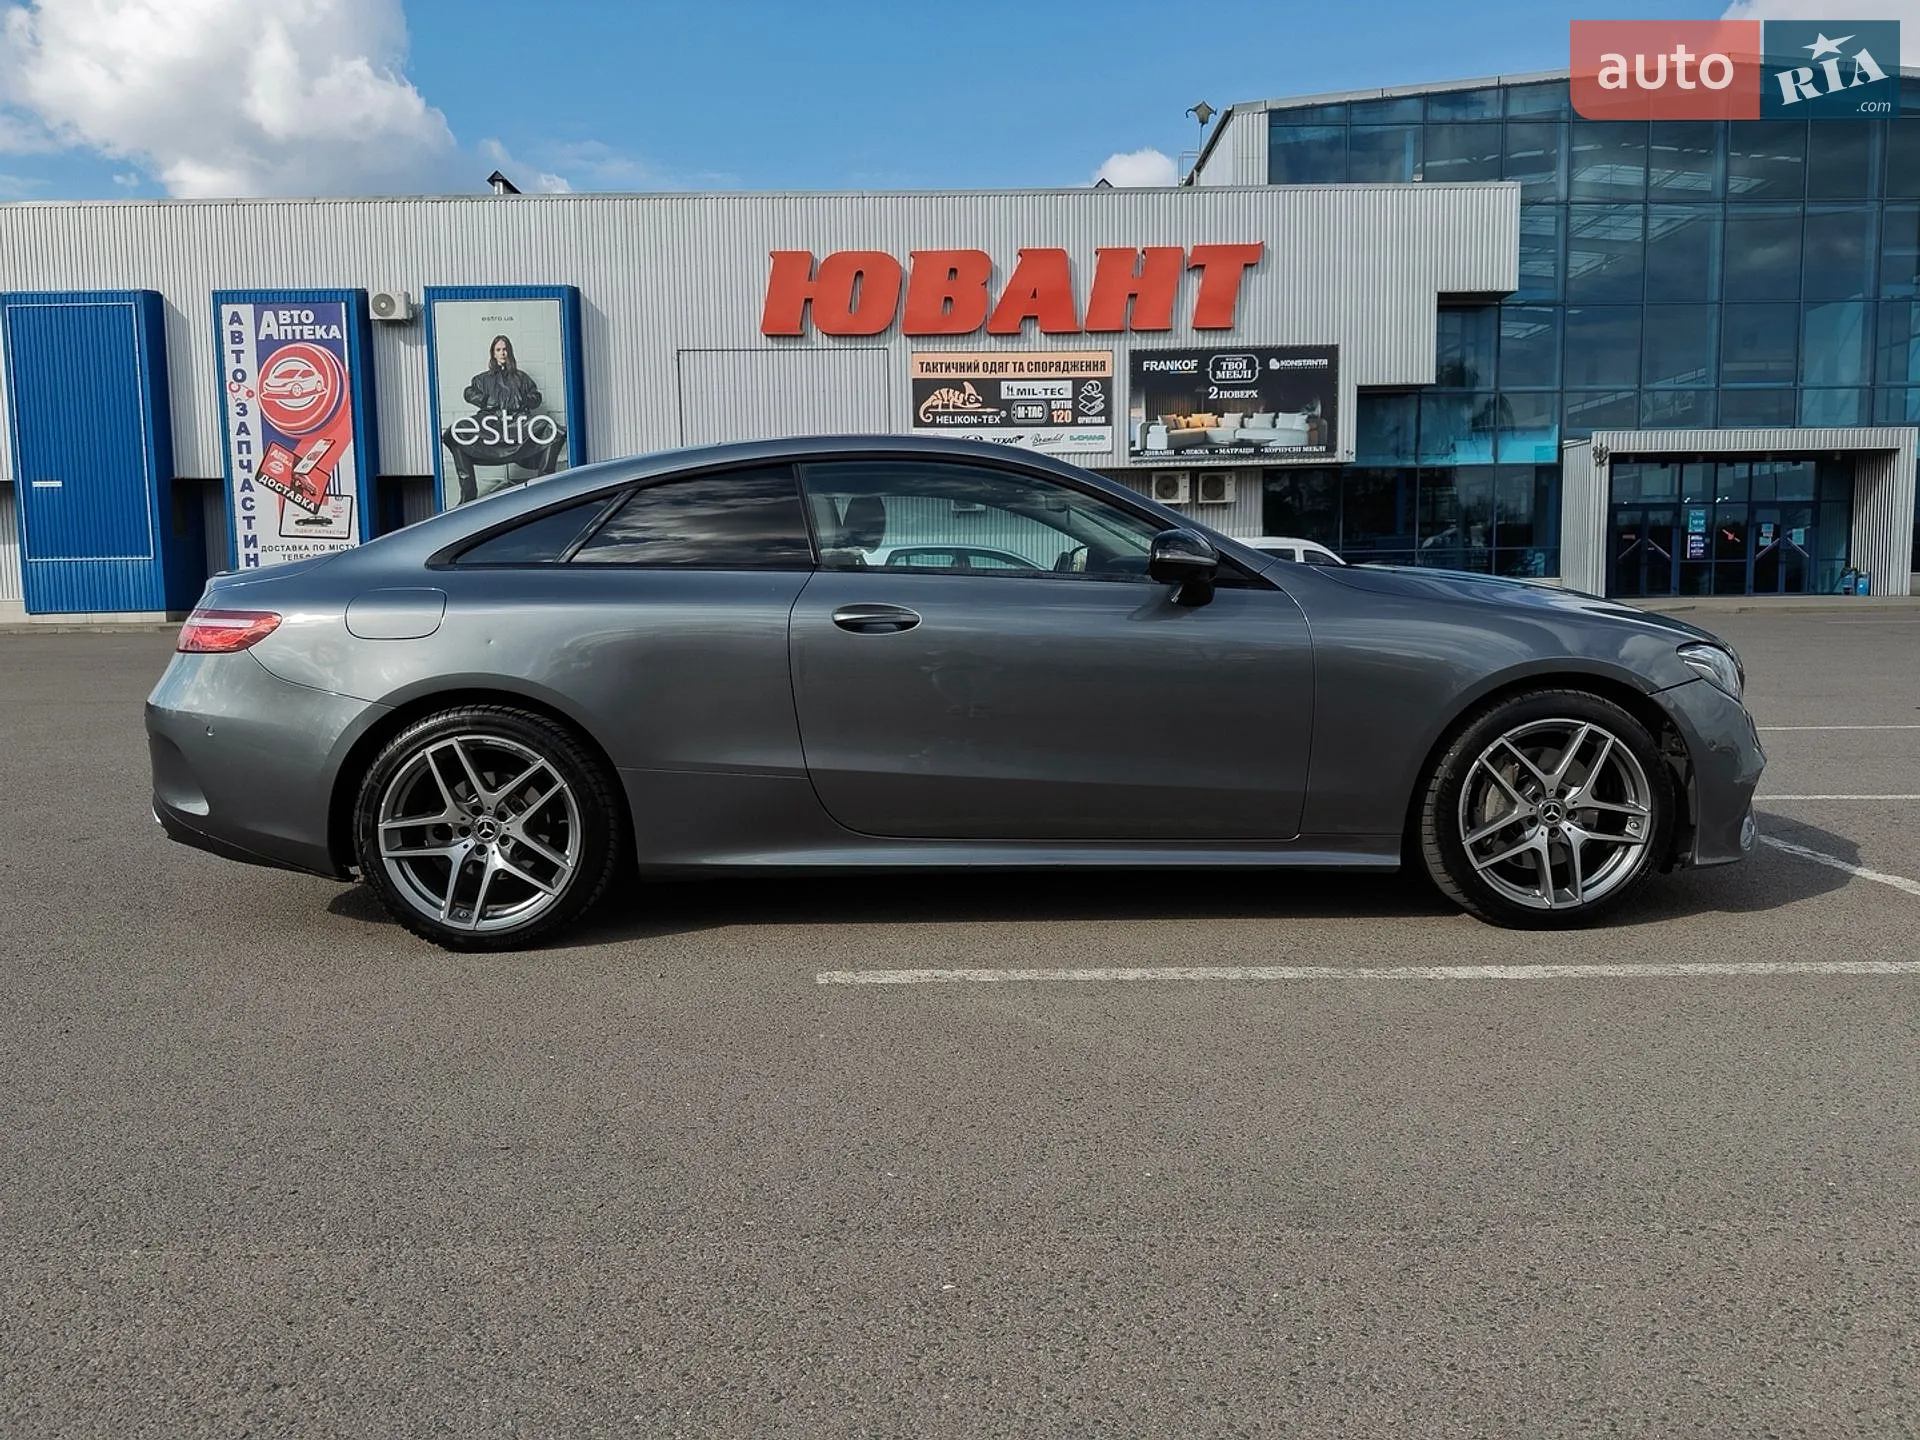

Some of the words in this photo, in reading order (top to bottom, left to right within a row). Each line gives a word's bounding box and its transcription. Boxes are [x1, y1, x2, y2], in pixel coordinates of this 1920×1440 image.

[761, 241, 1264, 336] ЮВАНТ
[919, 359, 979, 374] ТАКТИЧНИЙ
[982, 361, 1010, 375] ОДЯГ
[1012, 361, 1025, 373] ТА
[1027, 360, 1106, 374] СПОРЯДЖЕННЯ
[1143, 359, 1198, 371] FRANKOF
[1220, 359, 1248, 370] ТВОЇ
[1216, 370, 1252, 379] МЕБЛІ
[1208, 386, 1218, 399] 2
[1219, 390, 1258, 399] ПОВЕРХ
[936, 415, 1000, 424] HELIKON-TEX
[1052, 410, 1072, 423] 120
[451, 410, 557, 445] estro
[259, 474, 315, 511] ДОСТАВКА
[261, 544, 311, 552] ДОСТАВКА
[329, 543, 356, 551] МІСТУ
